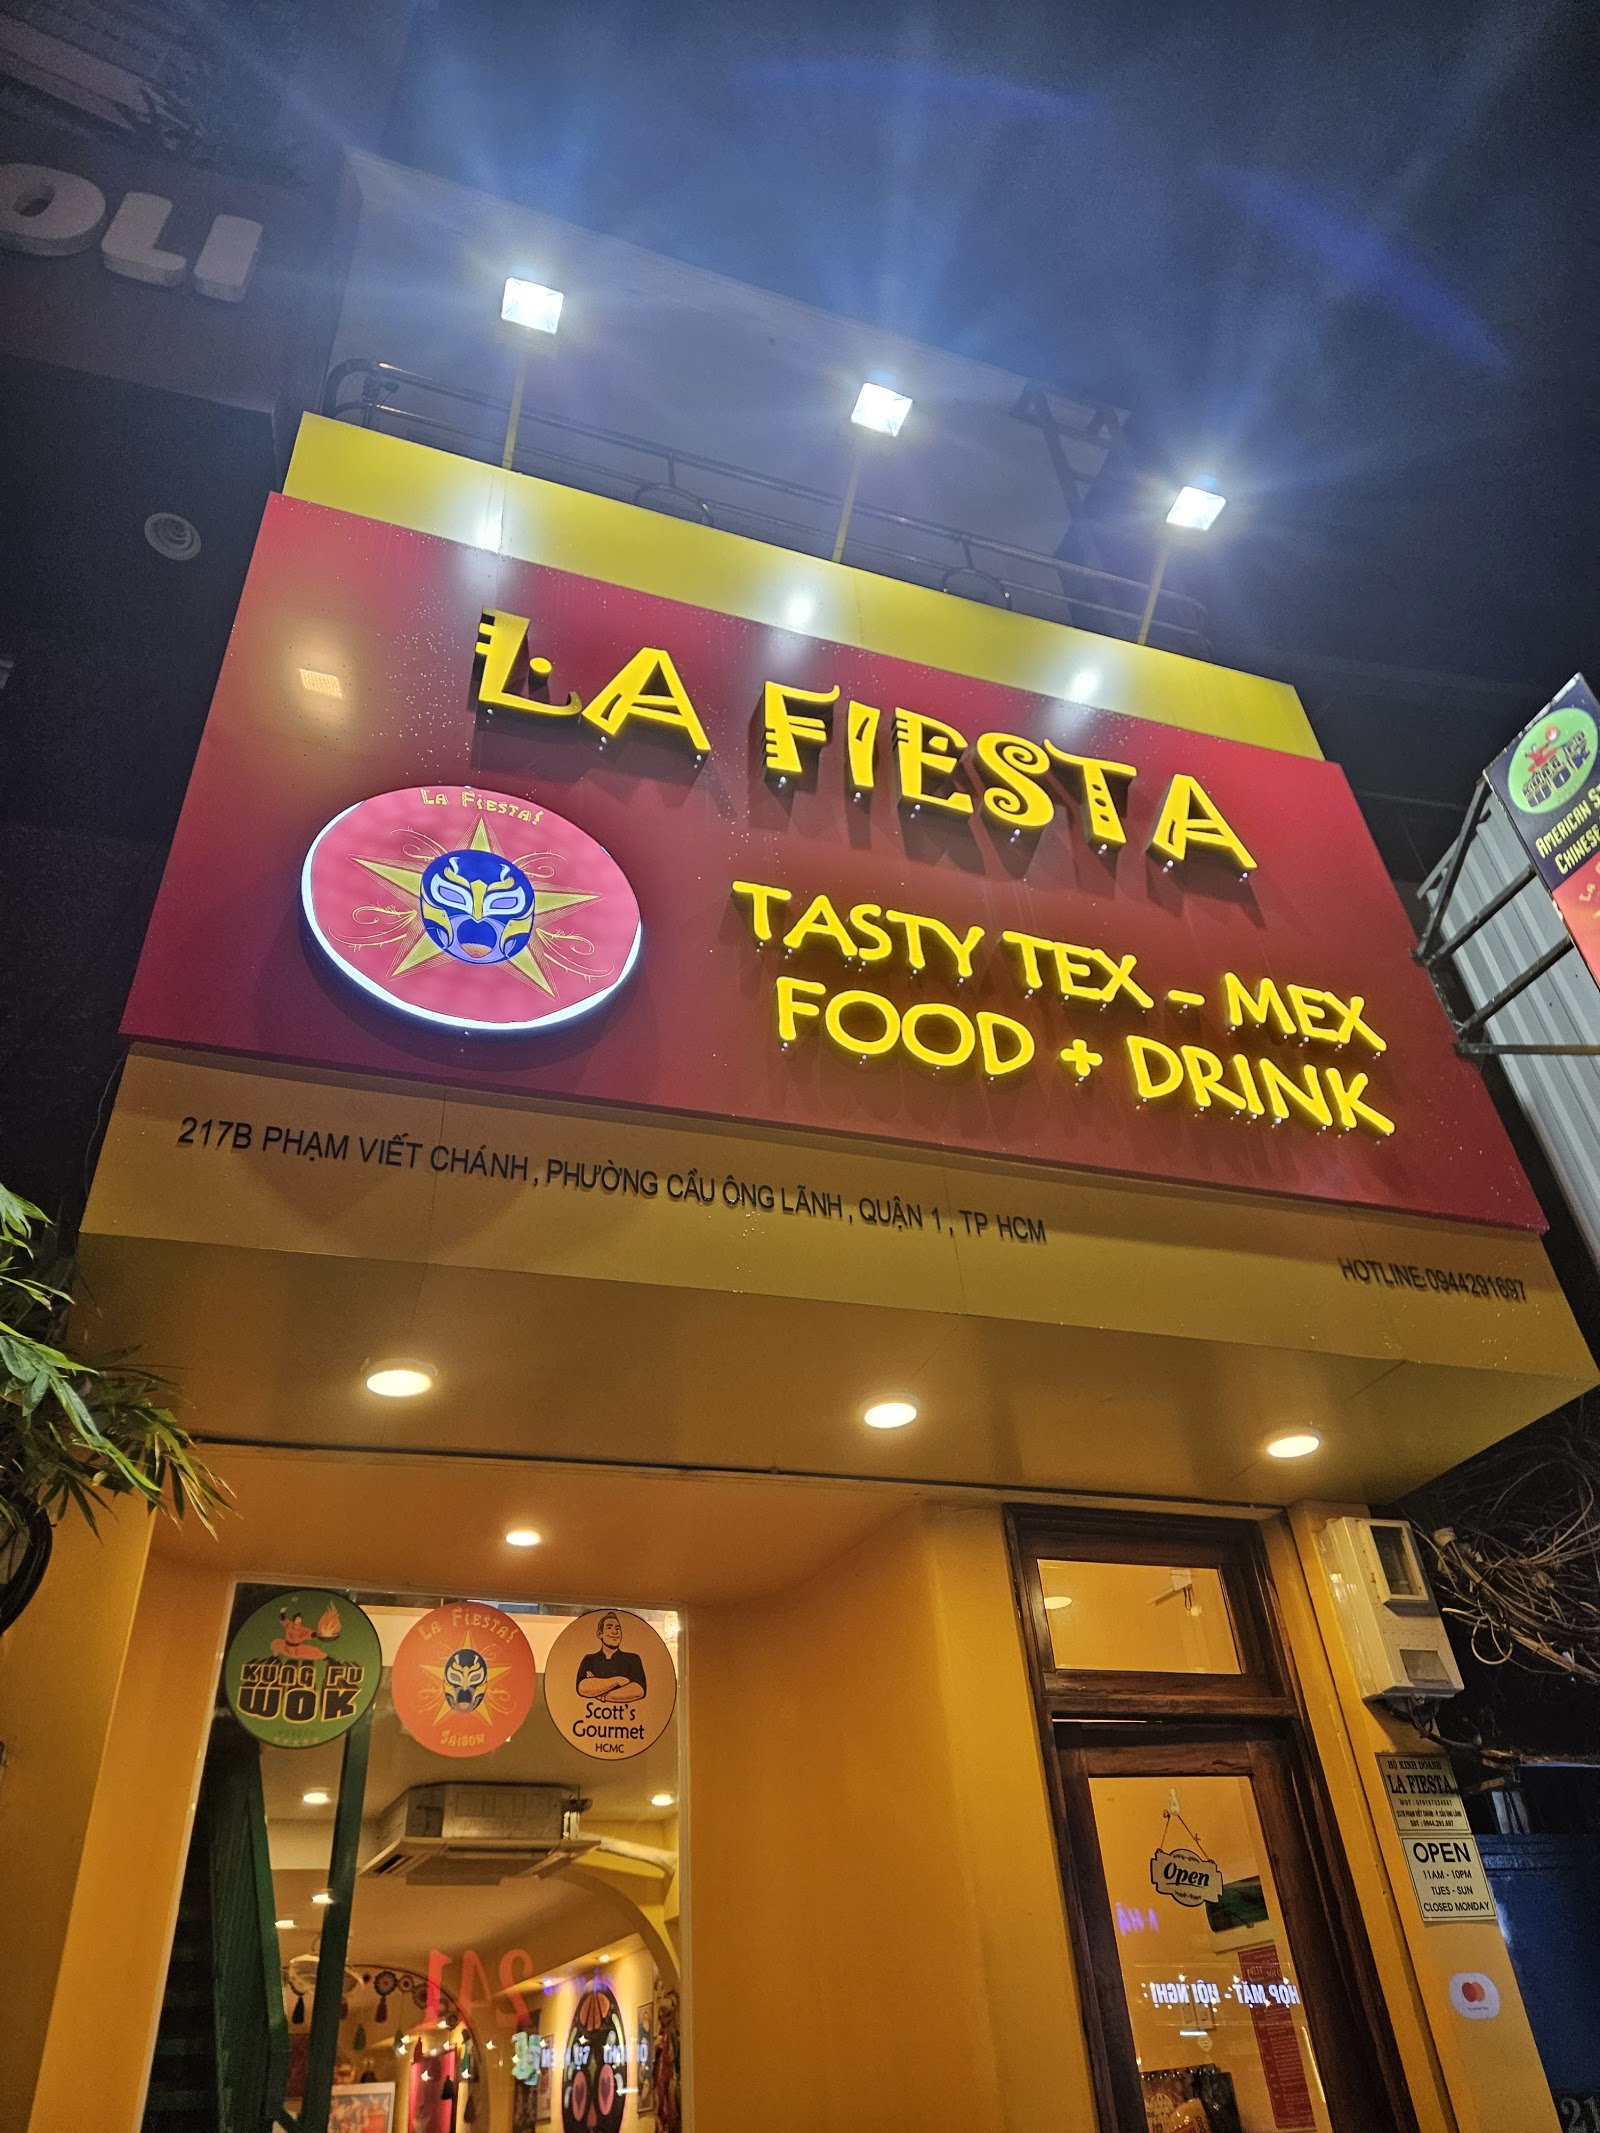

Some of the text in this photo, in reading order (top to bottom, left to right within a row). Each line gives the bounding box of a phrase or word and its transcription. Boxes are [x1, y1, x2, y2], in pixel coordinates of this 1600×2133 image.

[475, 606, 1257, 870] LA FIESTA
[1535, 799, 1592, 858] AMERICAN
[732, 881, 984, 977] TASTY
[1002, 930, 1154, 1009] TEX
[1224, 971, 1387, 1052] MEX
[776, 976, 1396, 1135] FOOD + DRINK
[178, 1116, 252, 1150] 217B
[262, 1125, 349, 1162] PHẠM
[358, 1132, 423, 1168] VIẾT
[546, 1159, 658, 1196] PHƯỜNG
[666, 1167, 715, 1202] CẦU
[723, 1174, 775, 1210] ÔNG
[858, 1195, 923, 1231] QUẬN
[958, 1209, 988, 1237] TP
[998, 1213, 1047, 1244] HCM
[240, 1660, 365, 1689] KUNG FU
[236, 1684, 363, 1724] WOK
[585, 1702, 636, 1721] Scott's
[572, 1720, 645, 1740] Gourmet
[595, 1743, 625, 1753] HCMC
[1387, 1774, 1456, 1794] LA FIESTA
[1413, 1842, 1472, 1864] OPEN
[1163, 1862, 1210, 1887] Open
[1423, 1870, 1445, 1880] 11AM
[1451, 1869, 1473, 1879] 10PM
[1431, 1886, 1451, 1896] TUES
[1457, 1885, 1474, 1895] SUN
[1423, 1901, 1490, 1912] CLOSED MONDAY
